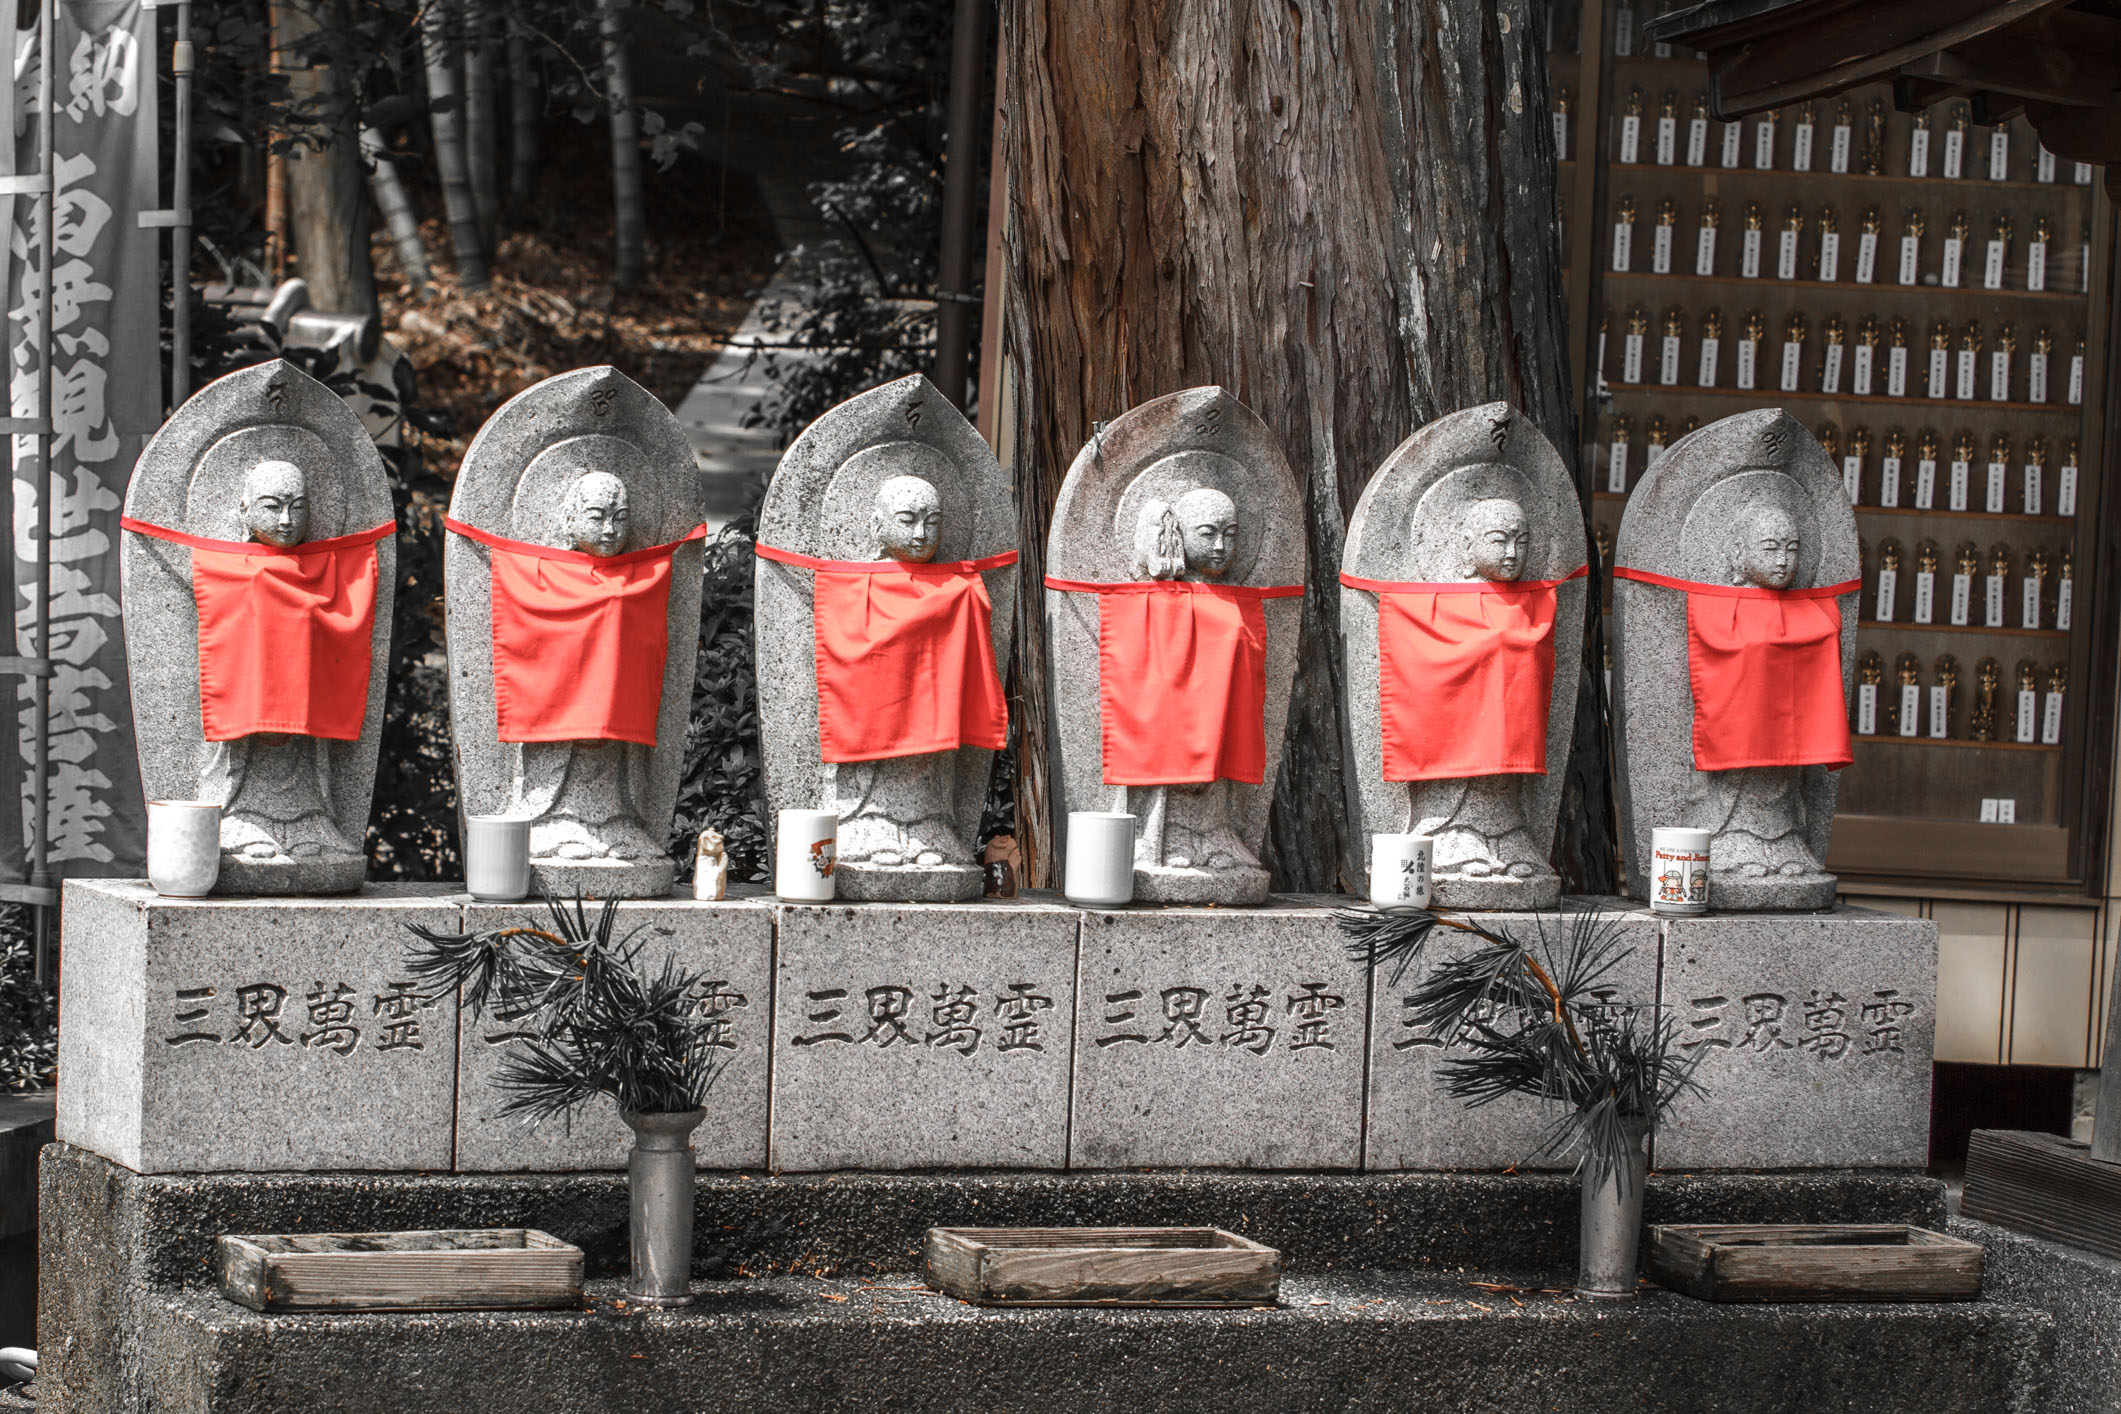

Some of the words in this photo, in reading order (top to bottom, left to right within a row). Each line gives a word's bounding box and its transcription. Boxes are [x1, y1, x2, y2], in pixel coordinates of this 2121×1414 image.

[1655, 850, 1675, 862] Patty
[1676, 852, 1692, 861] and
[165, 981, 436, 1057] 三界萬霊
[791, 982, 1055, 1057] 三界萬霊
[1095, 982, 1346, 1057] 三界萬霊
[1682, 989, 1915, 1060] 三界萬霊
